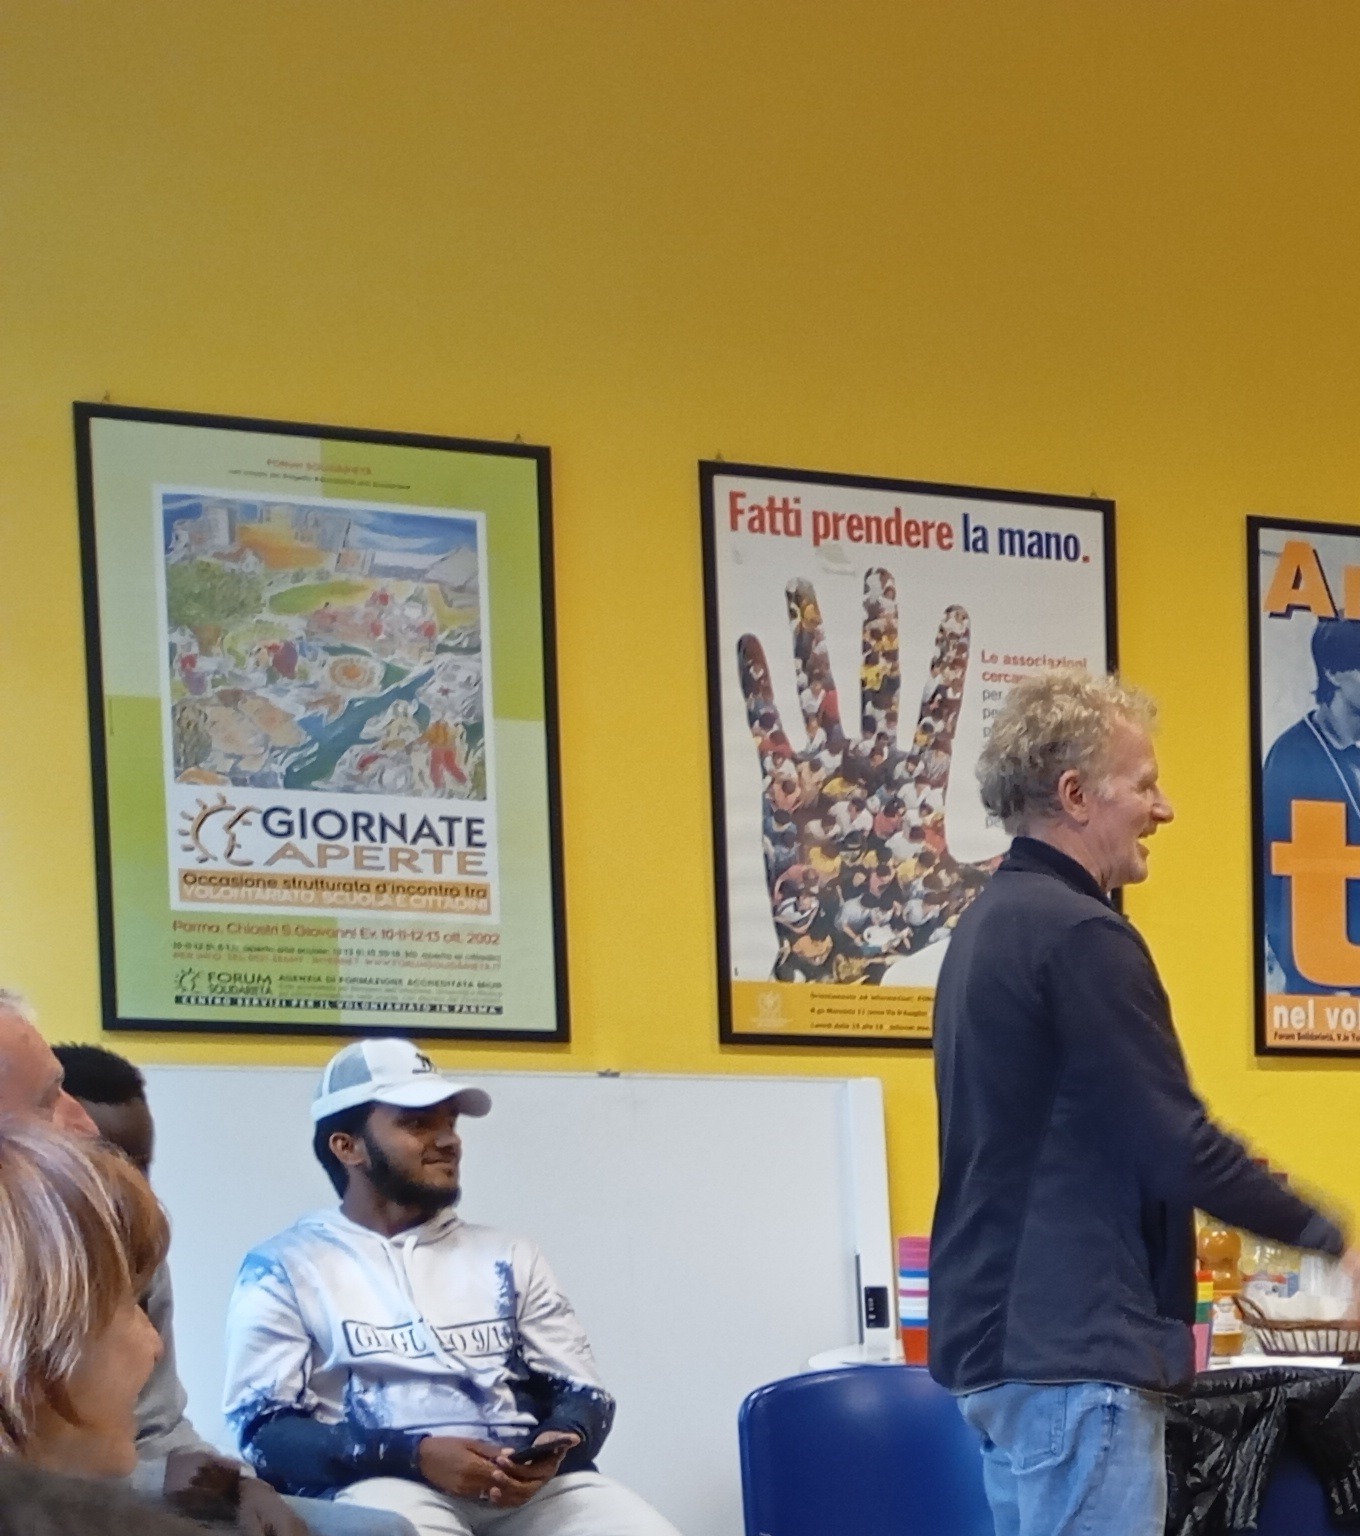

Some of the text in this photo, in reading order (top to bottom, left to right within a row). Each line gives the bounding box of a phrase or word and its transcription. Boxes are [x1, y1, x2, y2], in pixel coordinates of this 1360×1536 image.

[728, 490, 1090, 563] Fatti prendere la mano.
[981, 649, 1088, 669] Le associazioni
[983, 689, 1003, 702] per
[262, 806, 487, 849] GIORNATE
[263, 842, 488, 876] APERTE
[183, 872, 487, 899] Occasione strutturata d'incontro tra
[322, 890, 394, 907] SCUOLA
[407, 894, 488, 911] CITTADINI
[466, 933, 499, 945] 2002
[208, 971, 272, 985] FORUM
[1273, 999, 1315, 1030] nel
